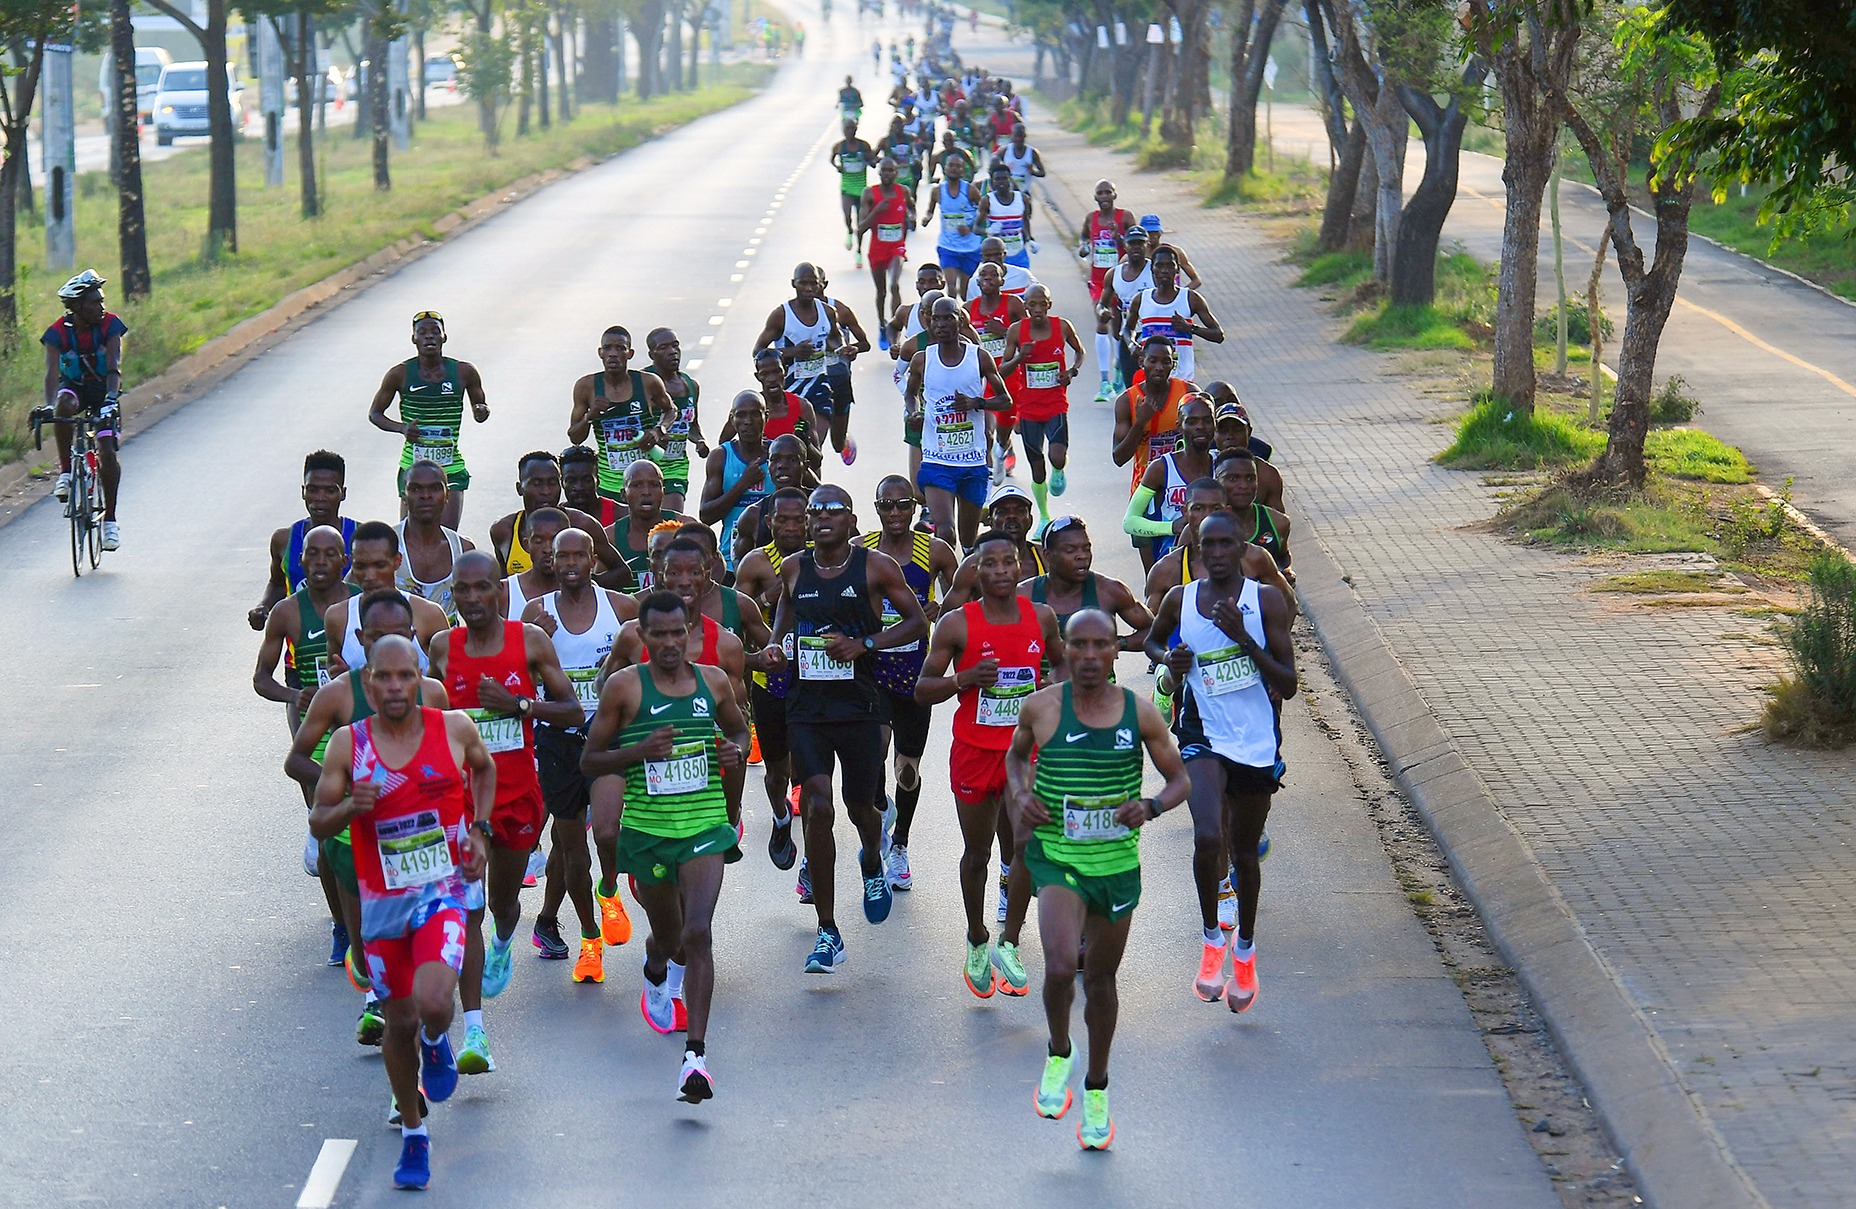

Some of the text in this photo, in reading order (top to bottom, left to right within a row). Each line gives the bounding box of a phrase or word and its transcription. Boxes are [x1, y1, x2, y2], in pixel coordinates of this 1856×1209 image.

[946, 431, 974, 446] 42621
[423, 447, 452, 461] 41899
[798, 590, 819, 599] GARMIN
[800, 651, 807, 660] A
[320, 671, 328, 679] A
[575, 682, 599, 700] 419
[980, 699, 989, 707] A
[994, 699, 1024, 717] 448
[648, 764, 657, 773] A
[664, 757, 707, 782] 41850
[648, 776, 662, 784] MO
[1066, 811, 1076, 820] A
[1083, 809, 1121, 830] 418
[384, 856, 393, 866] A
[401, 843, 449, 875] 41975
